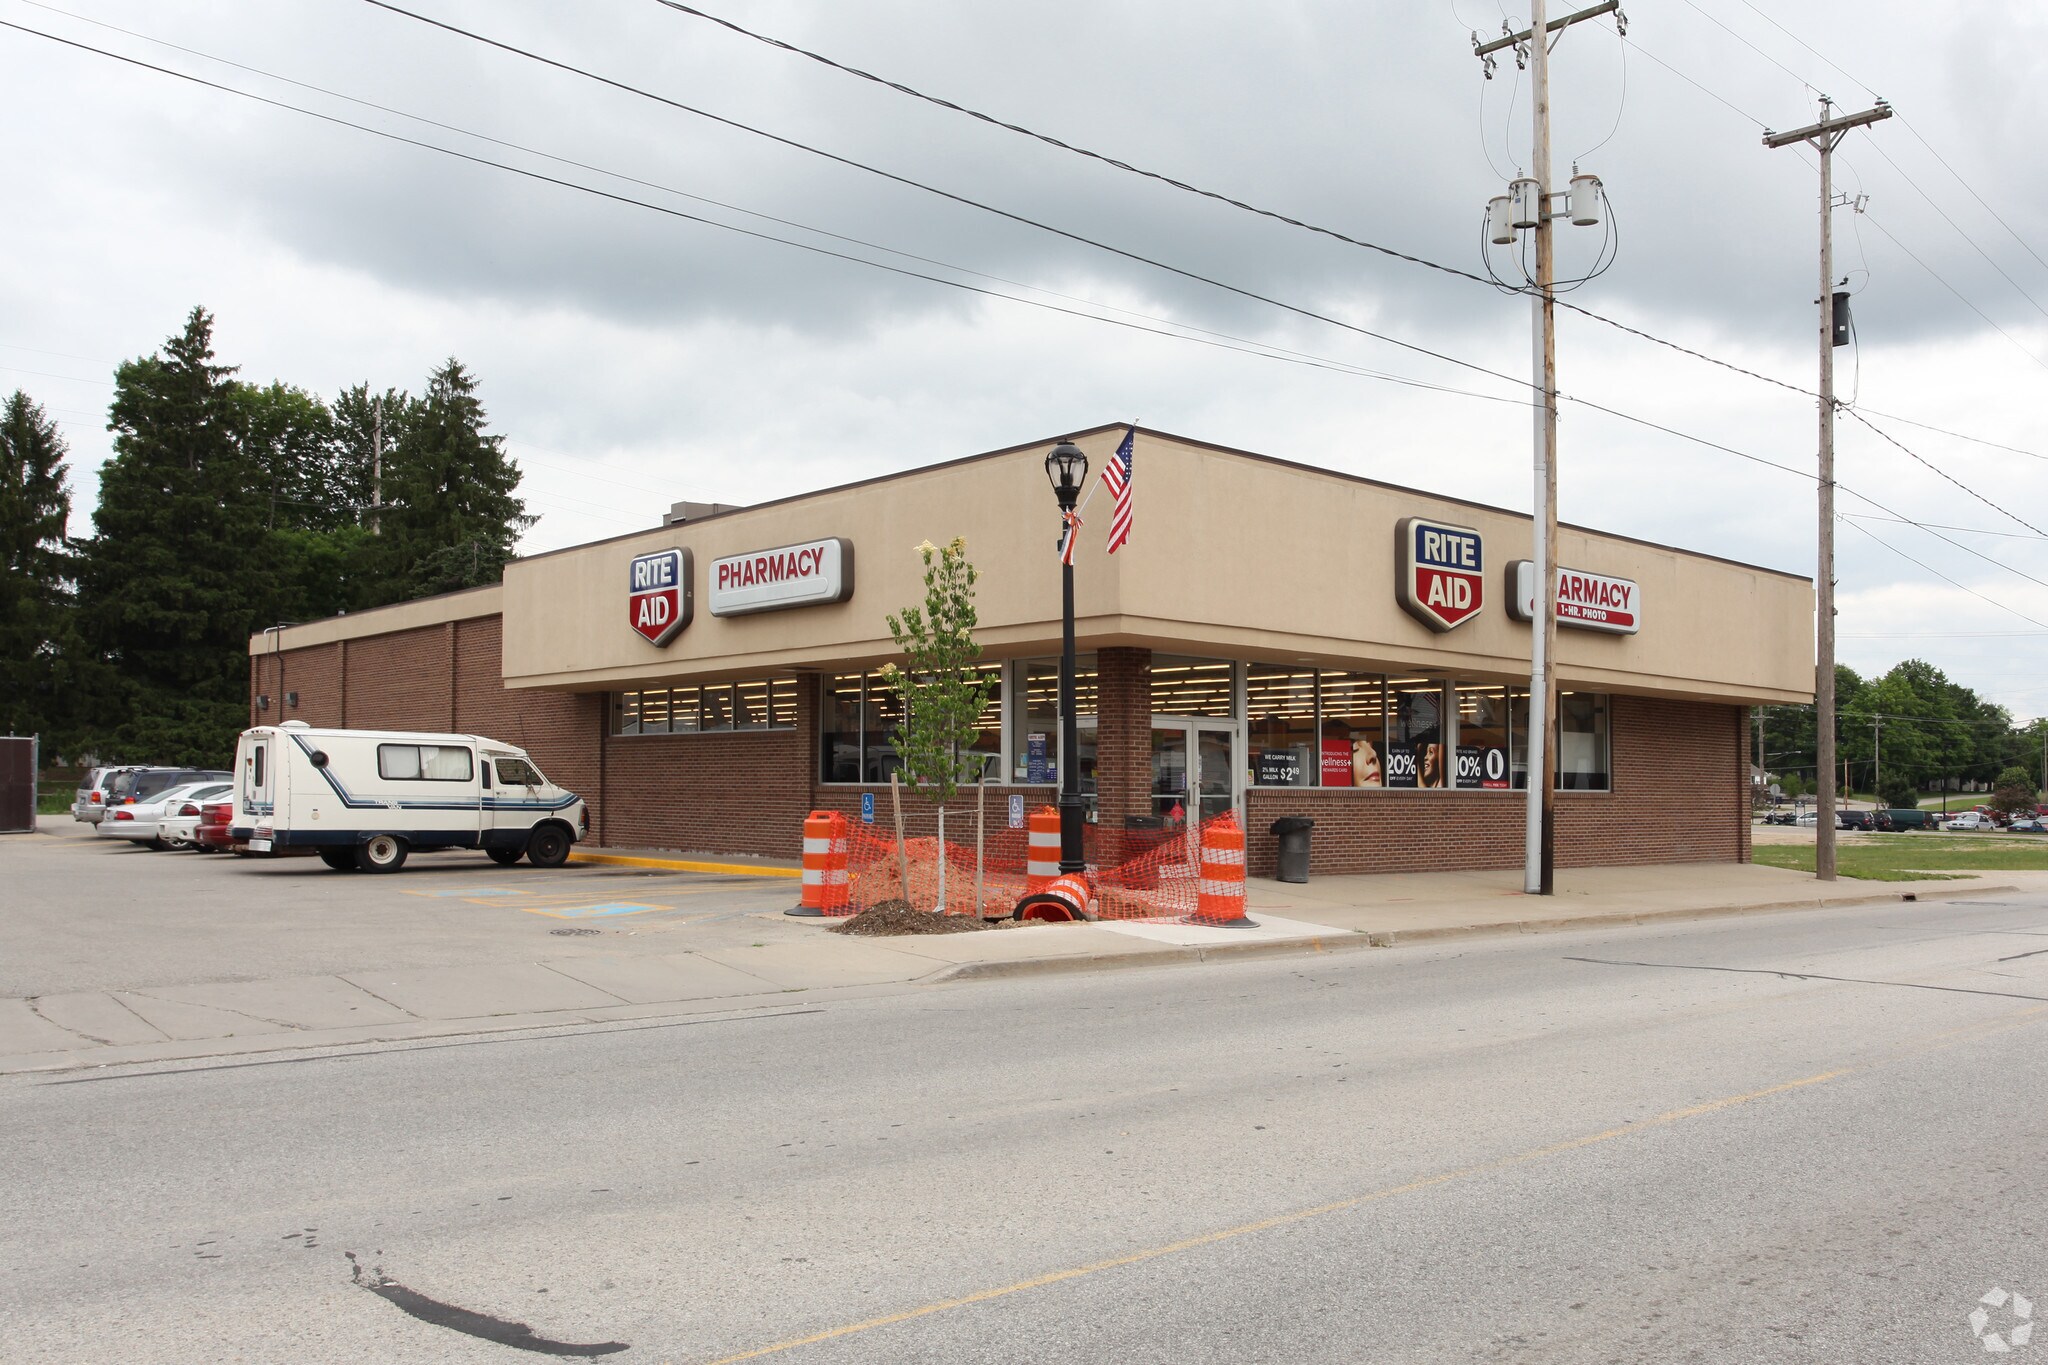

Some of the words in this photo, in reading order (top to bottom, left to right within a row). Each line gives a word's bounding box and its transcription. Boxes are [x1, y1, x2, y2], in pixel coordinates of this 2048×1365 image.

[1424, 530, 1476, 567] RITE
[635, 556, 672, 589] RITE
[718, 546, 824, 590] PHARMACY
[1427, 574, 1472, 610] AID
[1558, 574, 1632, 609] ARMACY
[637, 595, 670, 628] AID
[1561, 604, 1581, 617] 1-HR.
[1582, 608, 1607, 620] PHOTO
[1388, 754, 1416, 775] 20%
[1456, 756, 1480, 776] 10%
